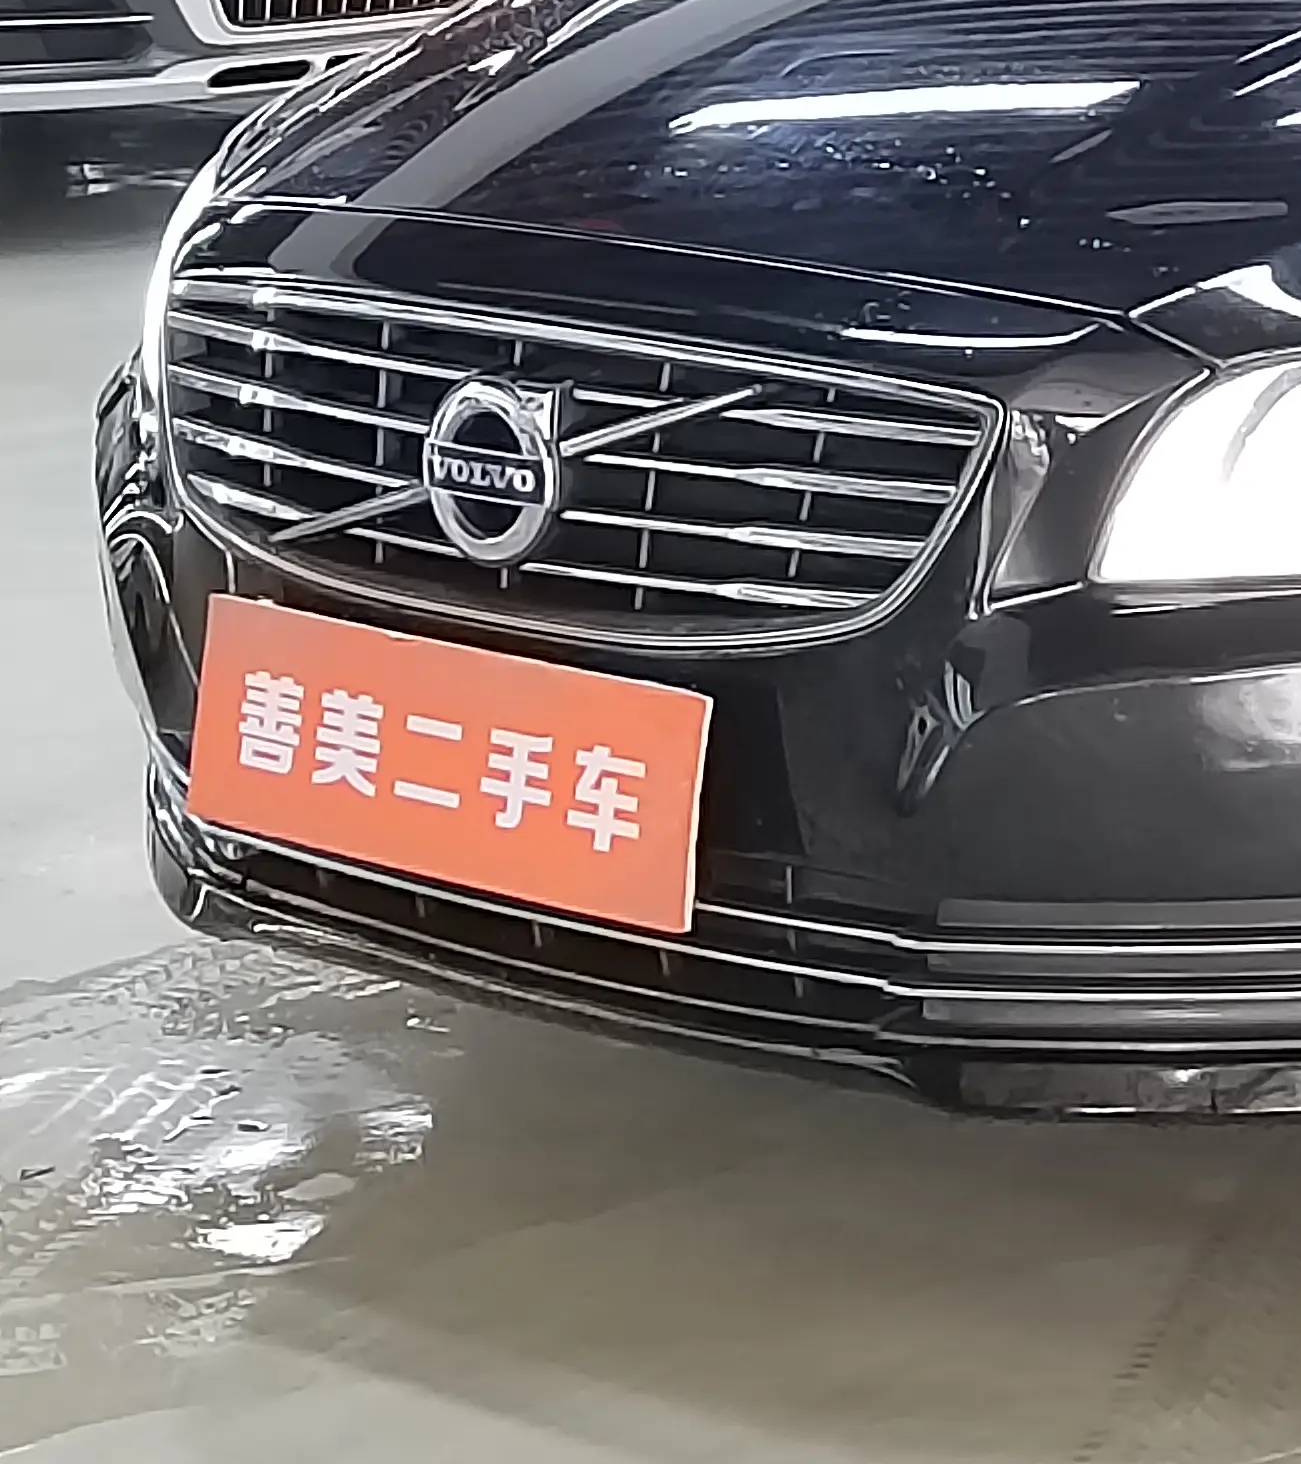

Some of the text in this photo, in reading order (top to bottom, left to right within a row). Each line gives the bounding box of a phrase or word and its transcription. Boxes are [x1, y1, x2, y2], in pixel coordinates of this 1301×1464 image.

[430, 454, 536, 493] VOLVO
[237, 670, 647, 853] 善美二手车
